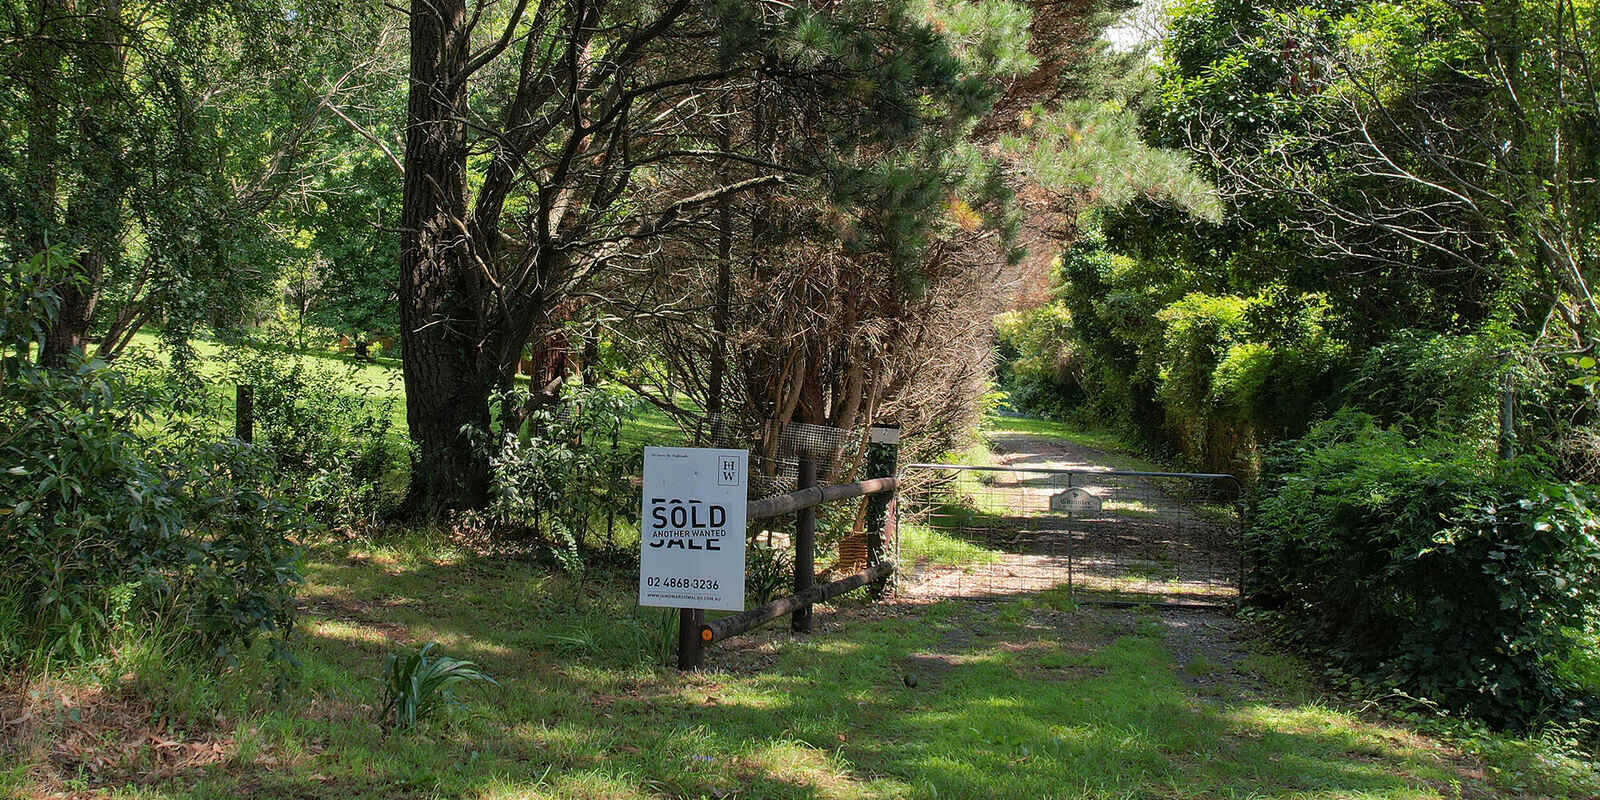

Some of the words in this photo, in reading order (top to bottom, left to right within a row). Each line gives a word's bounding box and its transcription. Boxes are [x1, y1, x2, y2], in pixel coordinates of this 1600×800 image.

[723, 471, 735, 481] W
[652, 505, 726, 529] SOLD
[652, 530, 690, 538] ANOTHER
[692, 529, 726, 537] WANTED
[647, 576, 660, 587] 02
[663, 577, 690, 588] 4868
[692, 579, 719, 590] 3236
